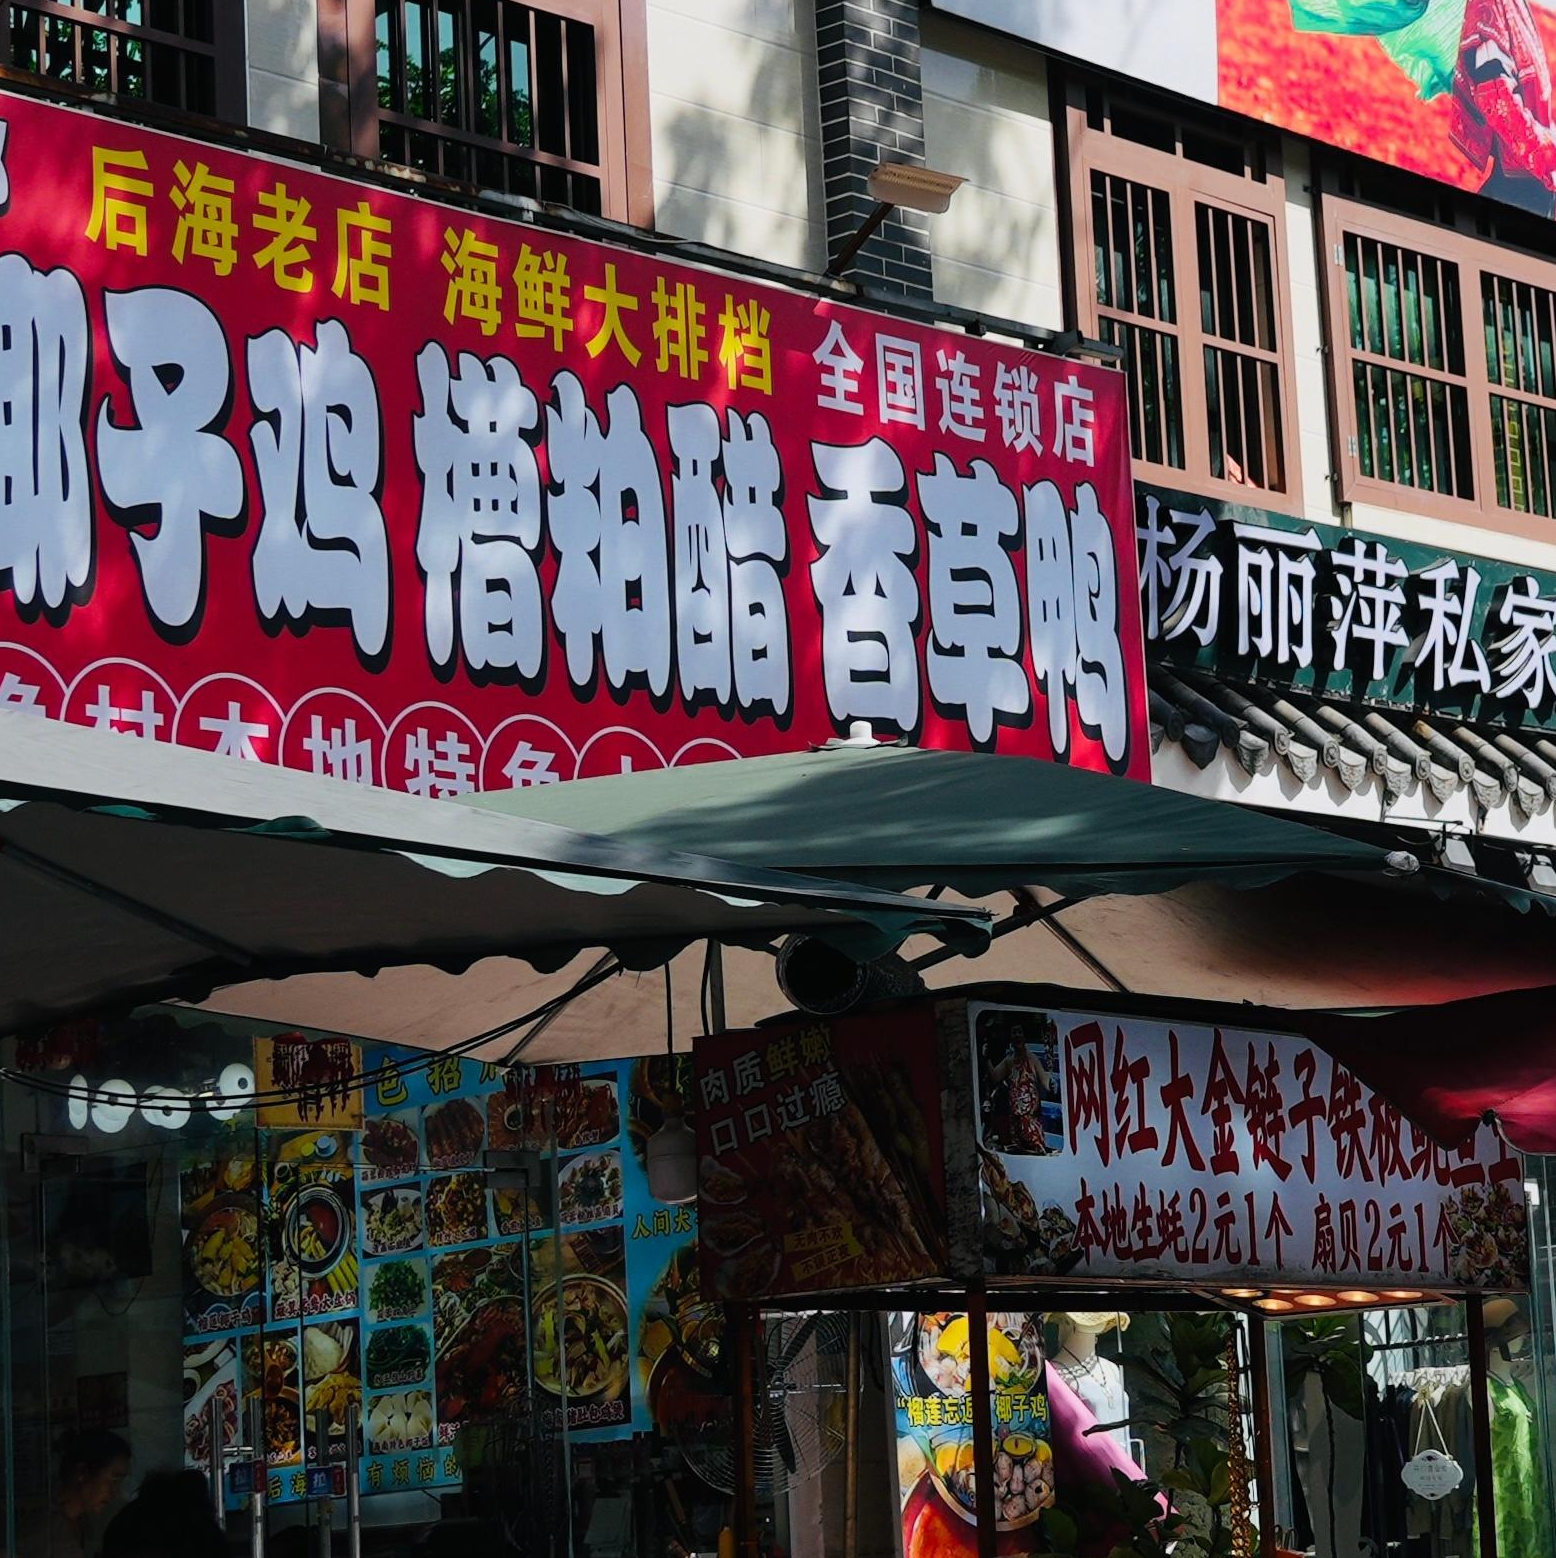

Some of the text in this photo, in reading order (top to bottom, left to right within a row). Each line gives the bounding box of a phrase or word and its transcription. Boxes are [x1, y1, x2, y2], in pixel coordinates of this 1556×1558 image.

[85, 147, 1096, 466] 后海老店 海鲜大排档 全国连锁店
[809, 436, 1129, 769] 香草鸭
[700, 1022, 832, 1110] 肉质鲜嫩
[710, 1070, 848, 1156] 口口过瘾
[1074, 1178, 1461, 1278] 本地生蚝2元1个 扇贝2元1个
[996, 1394, 1049, 1424] 椰子鸡
